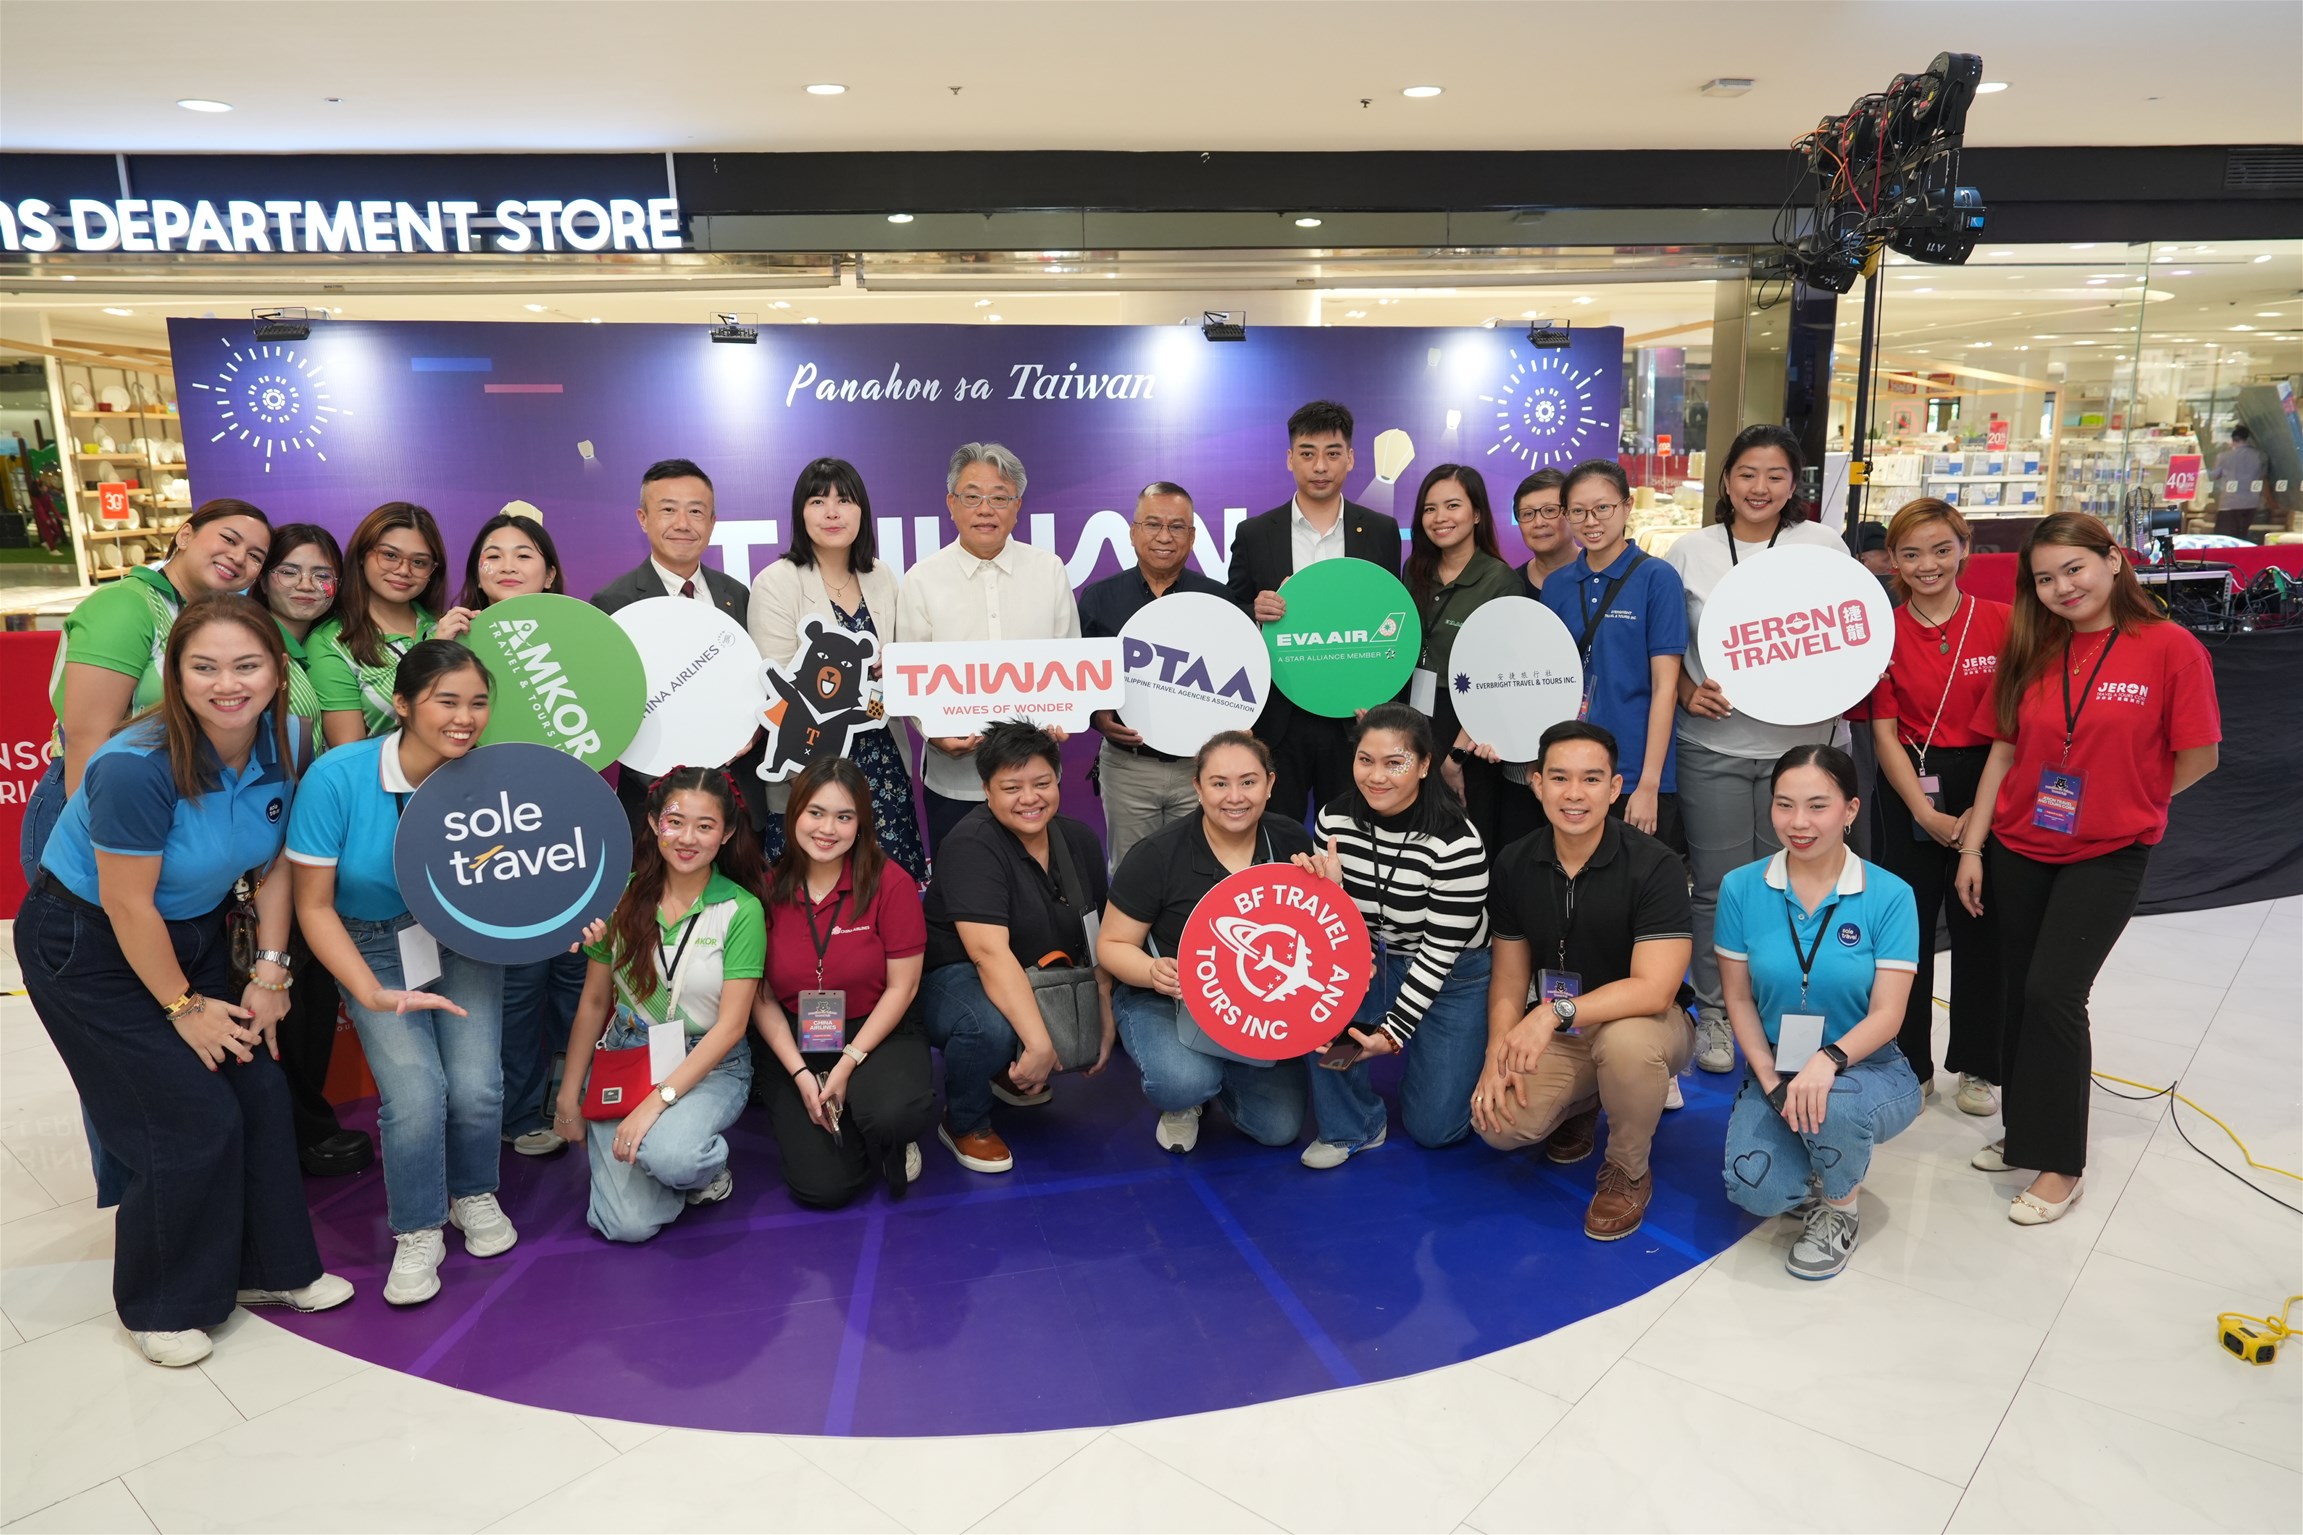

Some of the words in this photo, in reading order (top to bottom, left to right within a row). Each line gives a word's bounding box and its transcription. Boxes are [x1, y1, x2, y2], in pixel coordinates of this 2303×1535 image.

[70, 199, 478, 252] DEPARTMENT
[496, 199, 682, 252] STORE
[786, 362, 943, 407] Panahon
[954, 377, 994, 402] sa
[1008, 362, 1155, 401] Taiwan
[1722, 605, 1837, 649] JERON
[1843, 605, 1867, 642] 捷龍
[670, 644, 720, 692] AIRLINES
[1123, 636, 1257, 704] PTAA
[1285, 655, 1305, 663] STAR
[1307, 653, 1346, 662] ALLIANCE
[1347, 651, 1382, 660] MEMBER
[1724, 632, 1841, 671] TRAVEL
[489, 622, 521, 674] TRAVEL
[528, 694, 556, 738] TOURS
[499, 620, 601, 760] AMKOR
[896, 659, 1113, 696] TAIWAN
[1152, 682, 1177, 694] TRAVEL
[1178, 689, 1211, 702] AGENCIES
[1211, 697, 1255, 713] ASSOCIATION
[1476, 681, 1511, 690] EVERBRIGHT
[2097, 682, 2149, 698] JERON
[943, 705, 989, 716] WAVES
[993, 704, 1011, 714] OF
[1015, 702, 1074, 714] WONDER
[806, 727, 821, 746] T
[444, 790, 543, 842] sole
[449, 826, 586, 886] travel
[1233, 886, 1265, 915] BF
[1272, 884, 1349, 951] TRAVEL
[1196, 945, 1242, 1026] TOURS
[1310, 963, 1350, 1023] AND
[1240, 1015, 1288, 1040] INC
